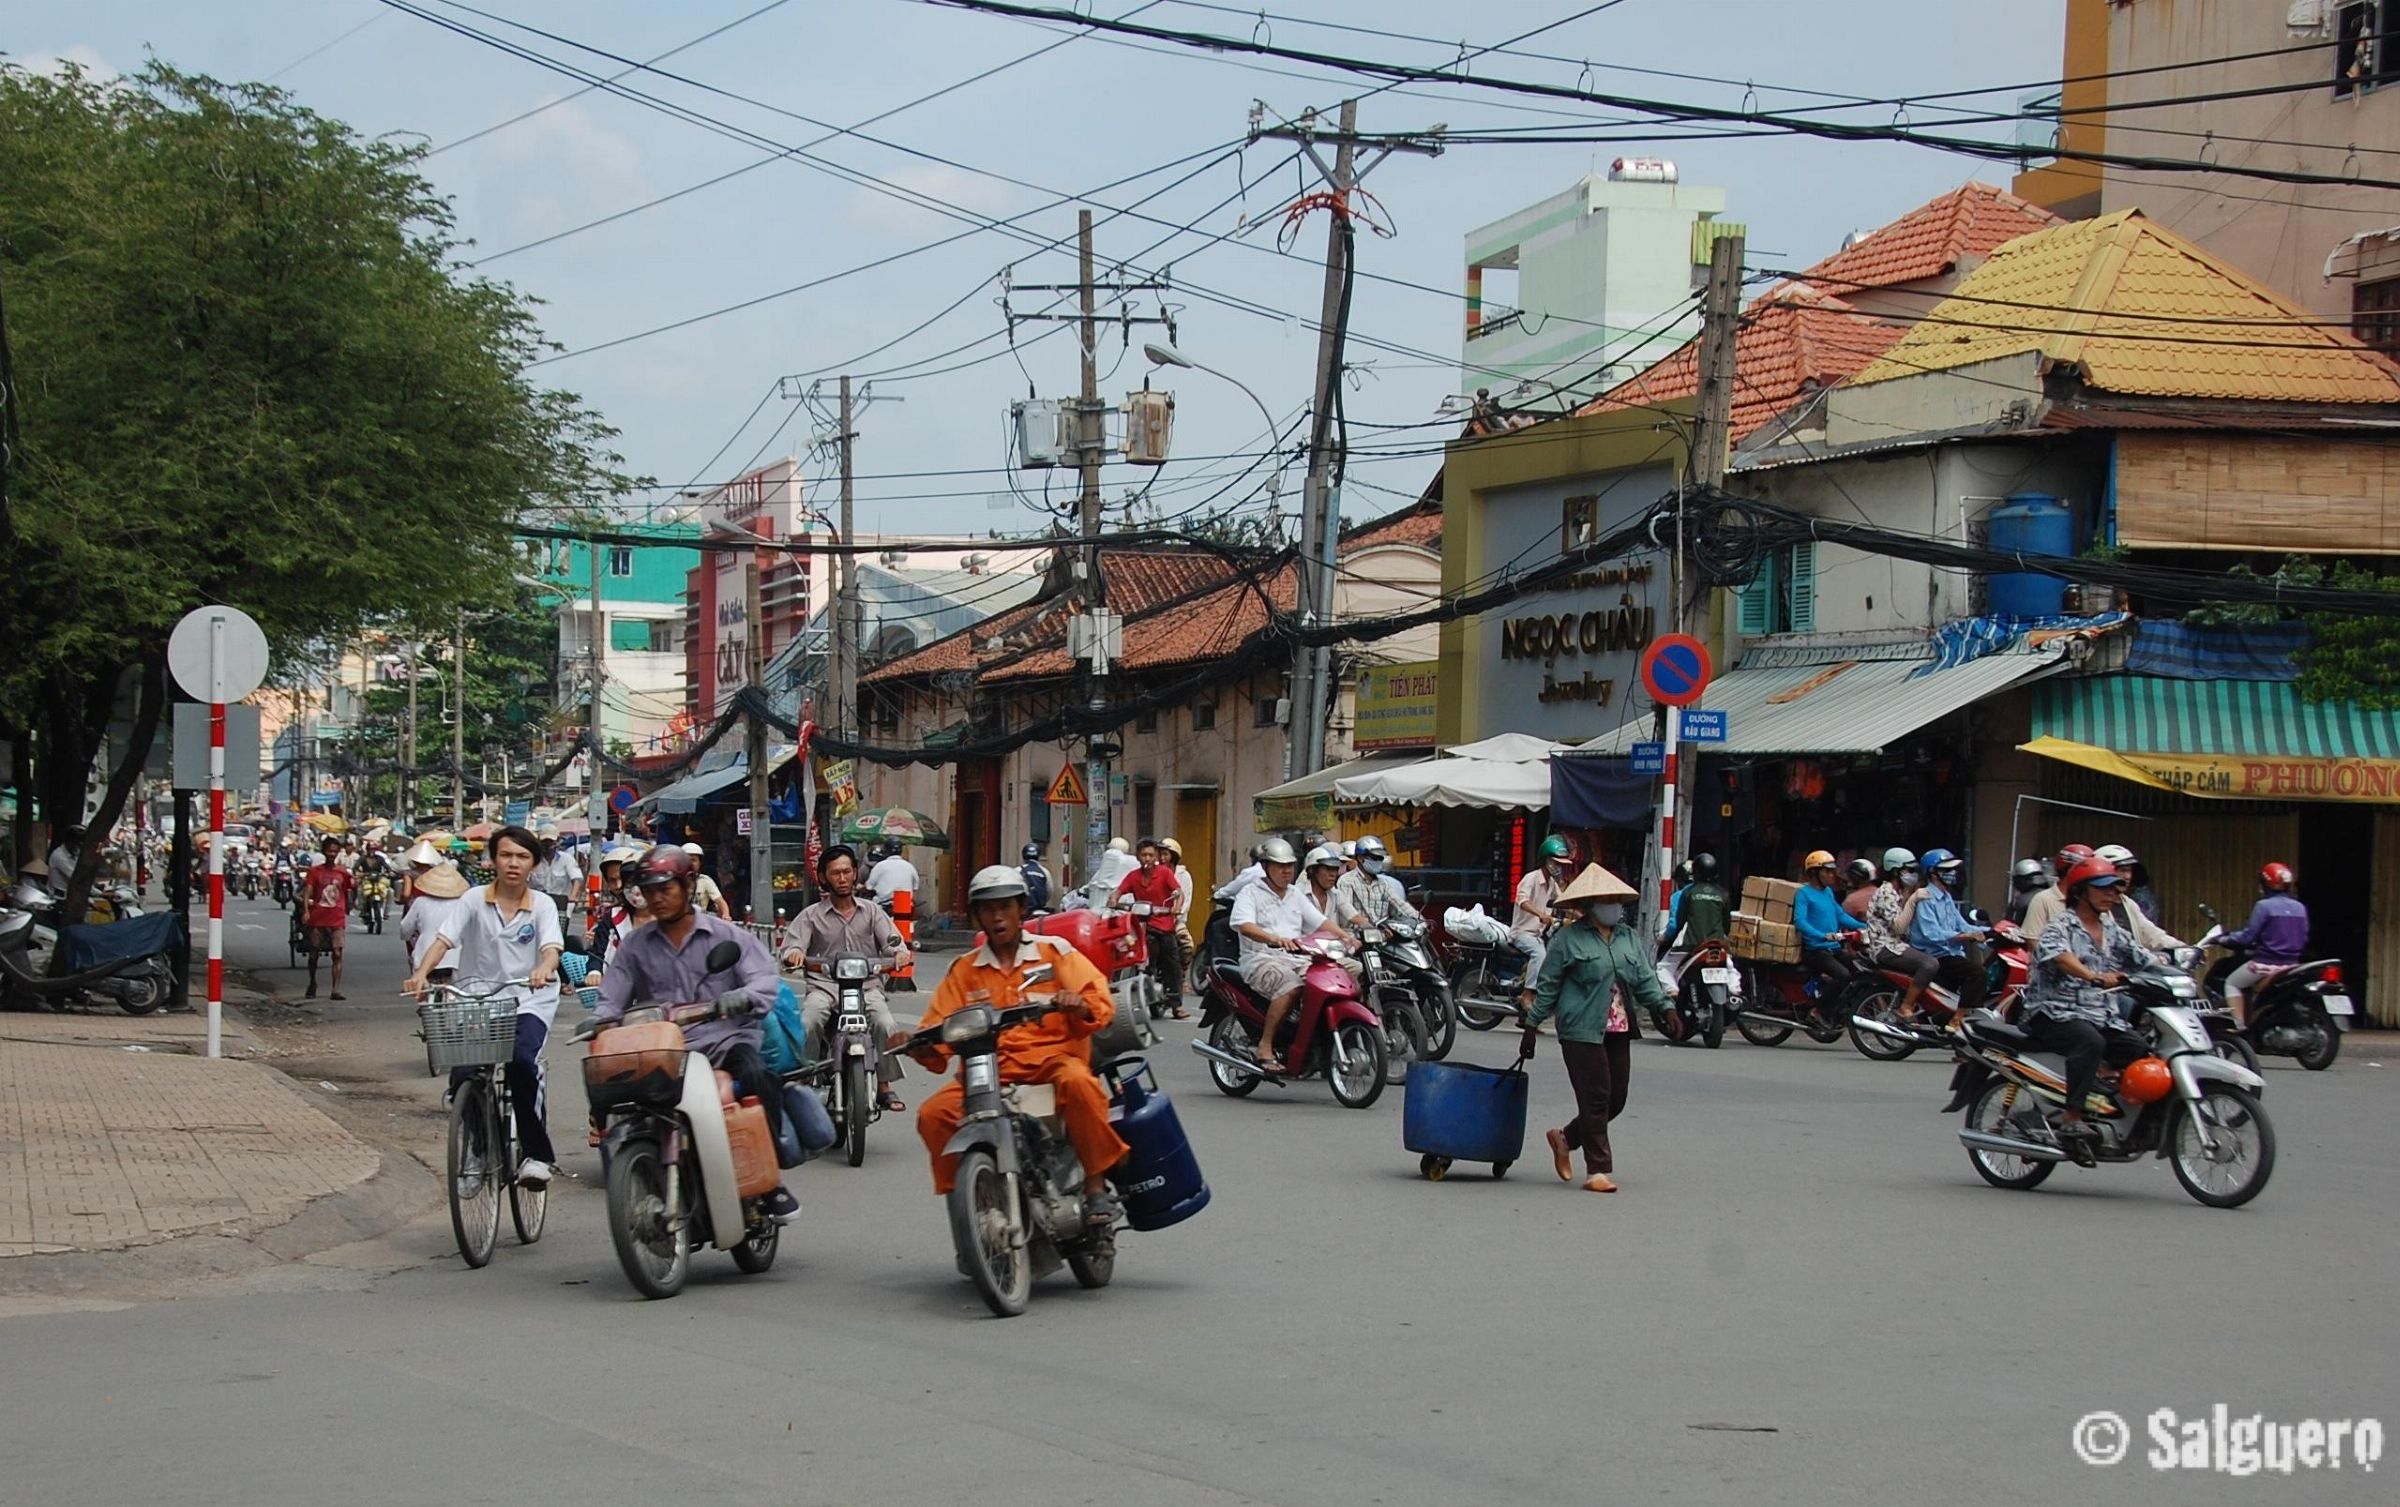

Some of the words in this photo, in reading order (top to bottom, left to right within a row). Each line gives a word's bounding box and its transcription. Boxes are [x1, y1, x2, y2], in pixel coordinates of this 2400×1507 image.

[1502, 614, 1578, 669] NGỌC
[2197, 761, 2230, 791] CẨM
[2240, 758, 2400, 796] PHƯƠN
